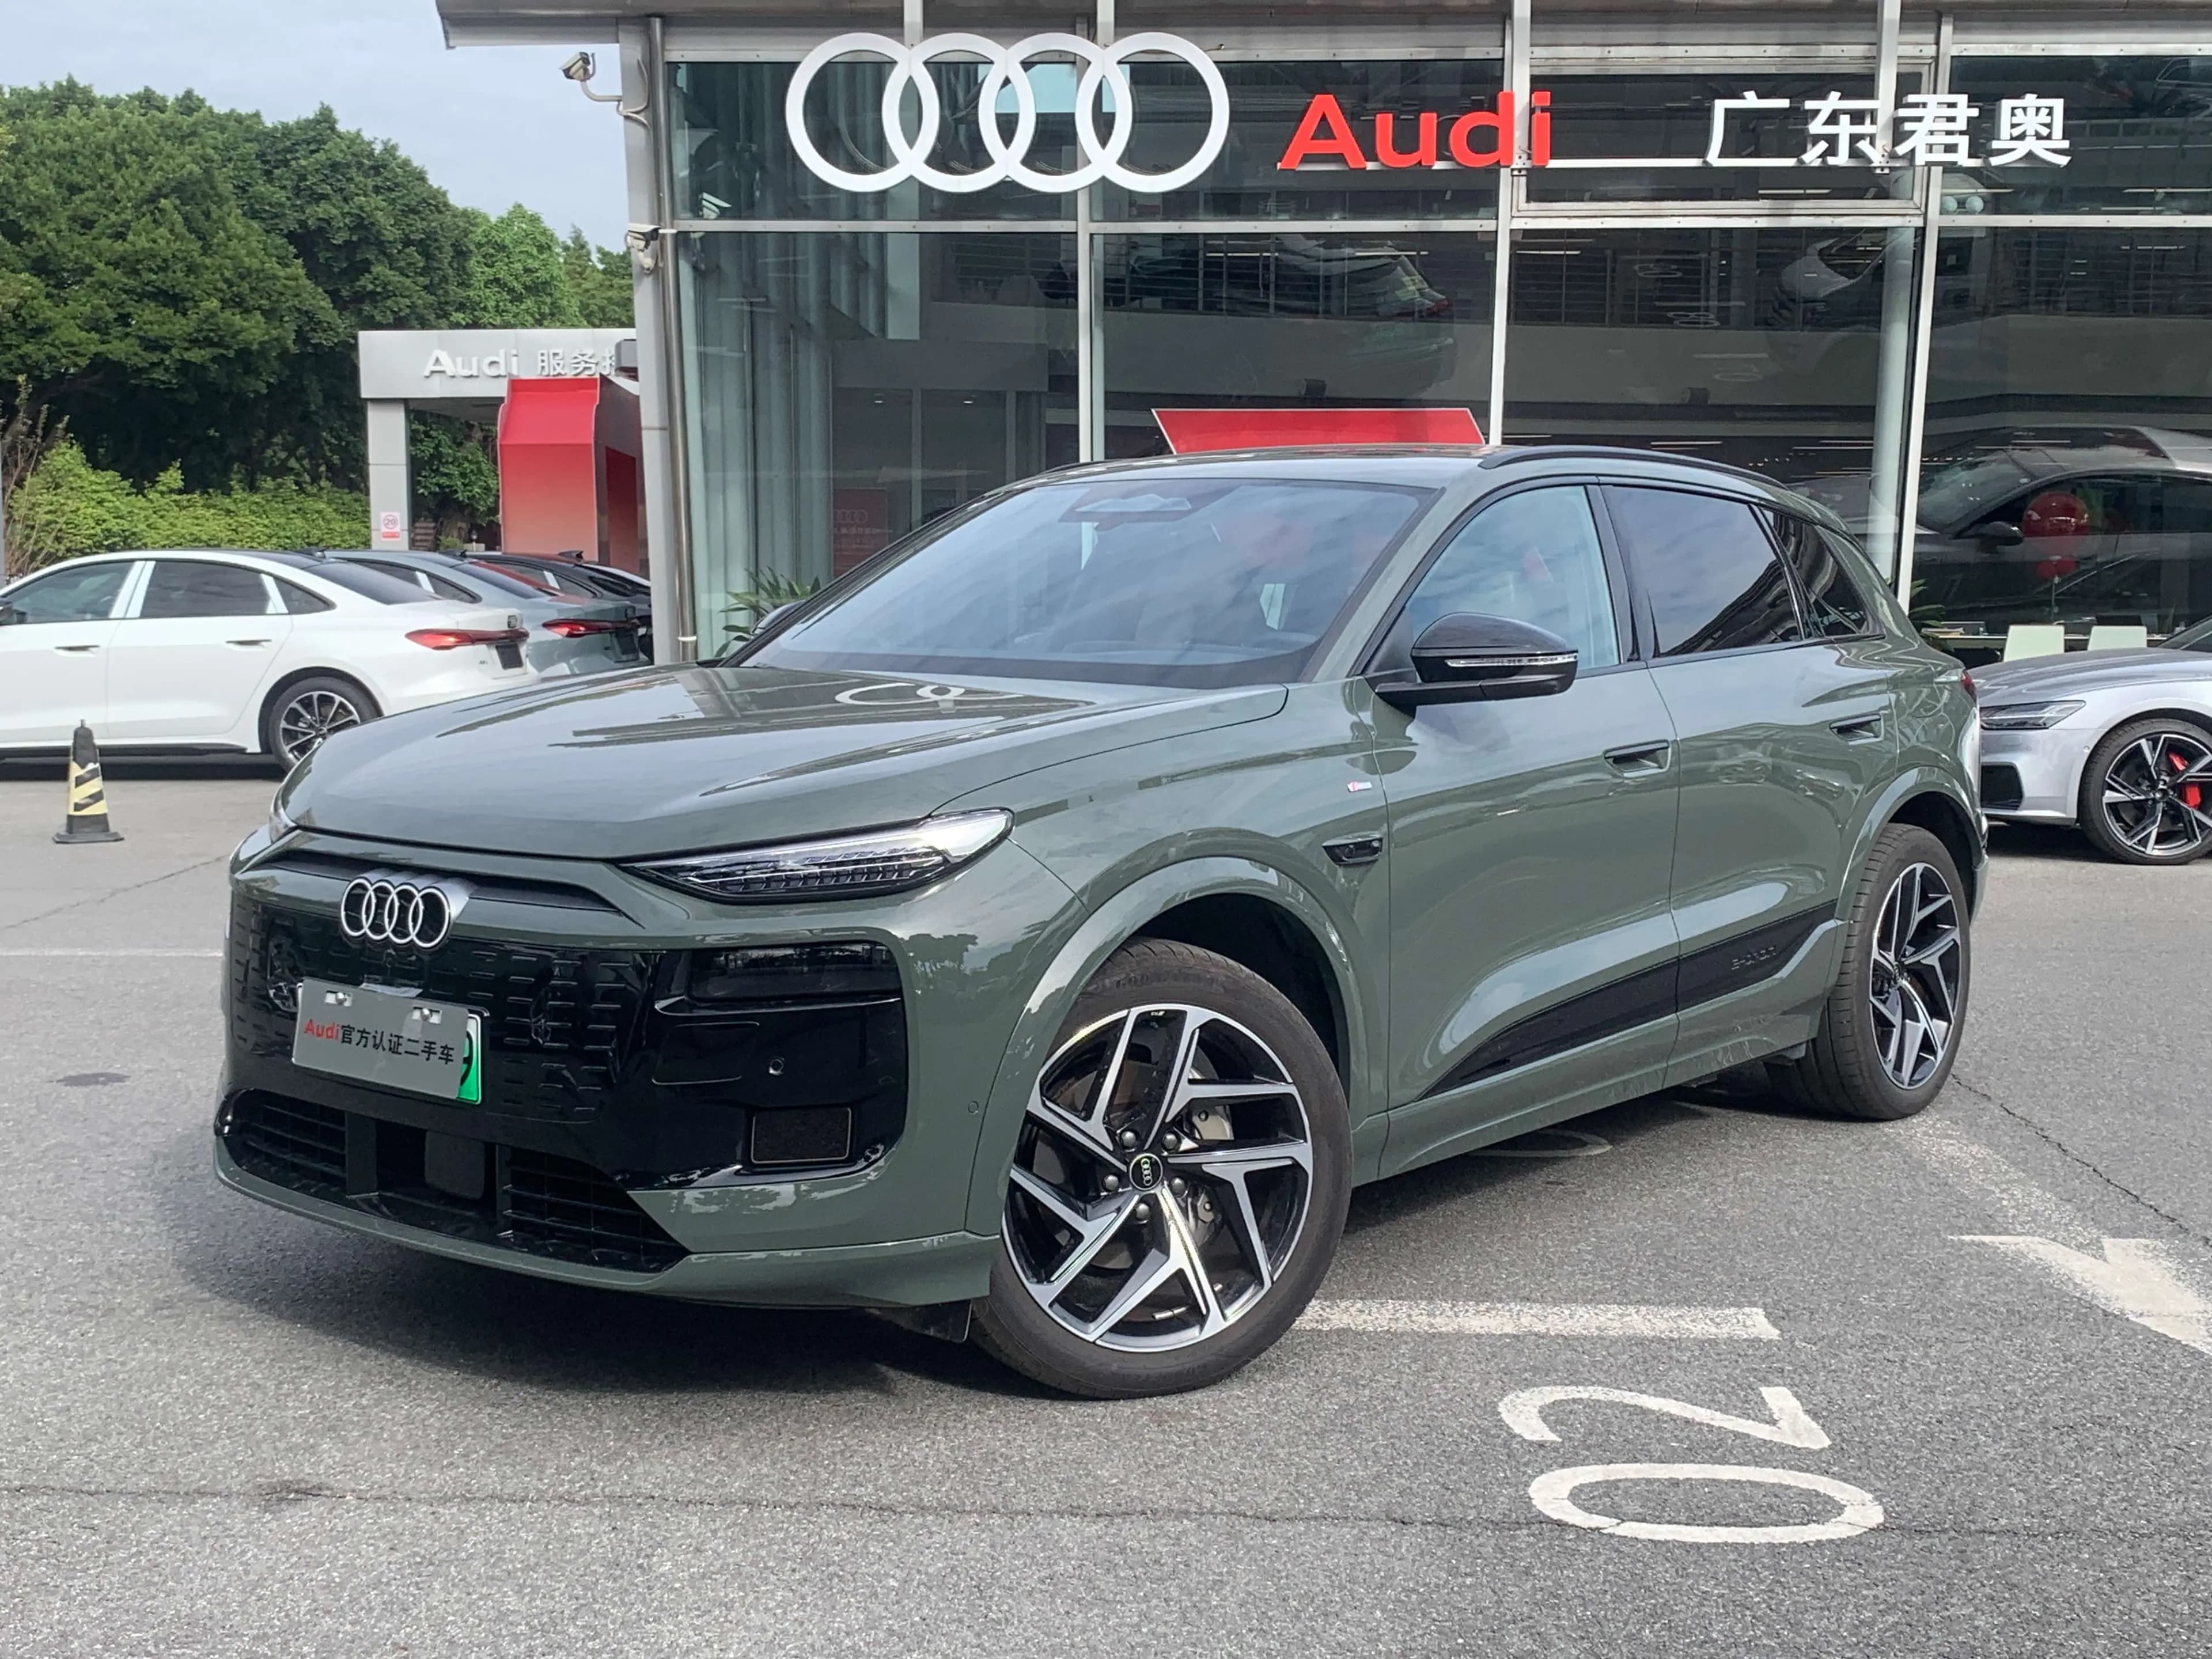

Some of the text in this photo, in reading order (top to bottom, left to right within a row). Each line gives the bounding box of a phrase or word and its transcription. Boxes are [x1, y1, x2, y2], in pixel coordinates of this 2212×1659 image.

[1278, 90, 2071, 169] Audi 广东君奥
[424, 349, 518, 377] Audi
[384, 518, 396, 526] 20
